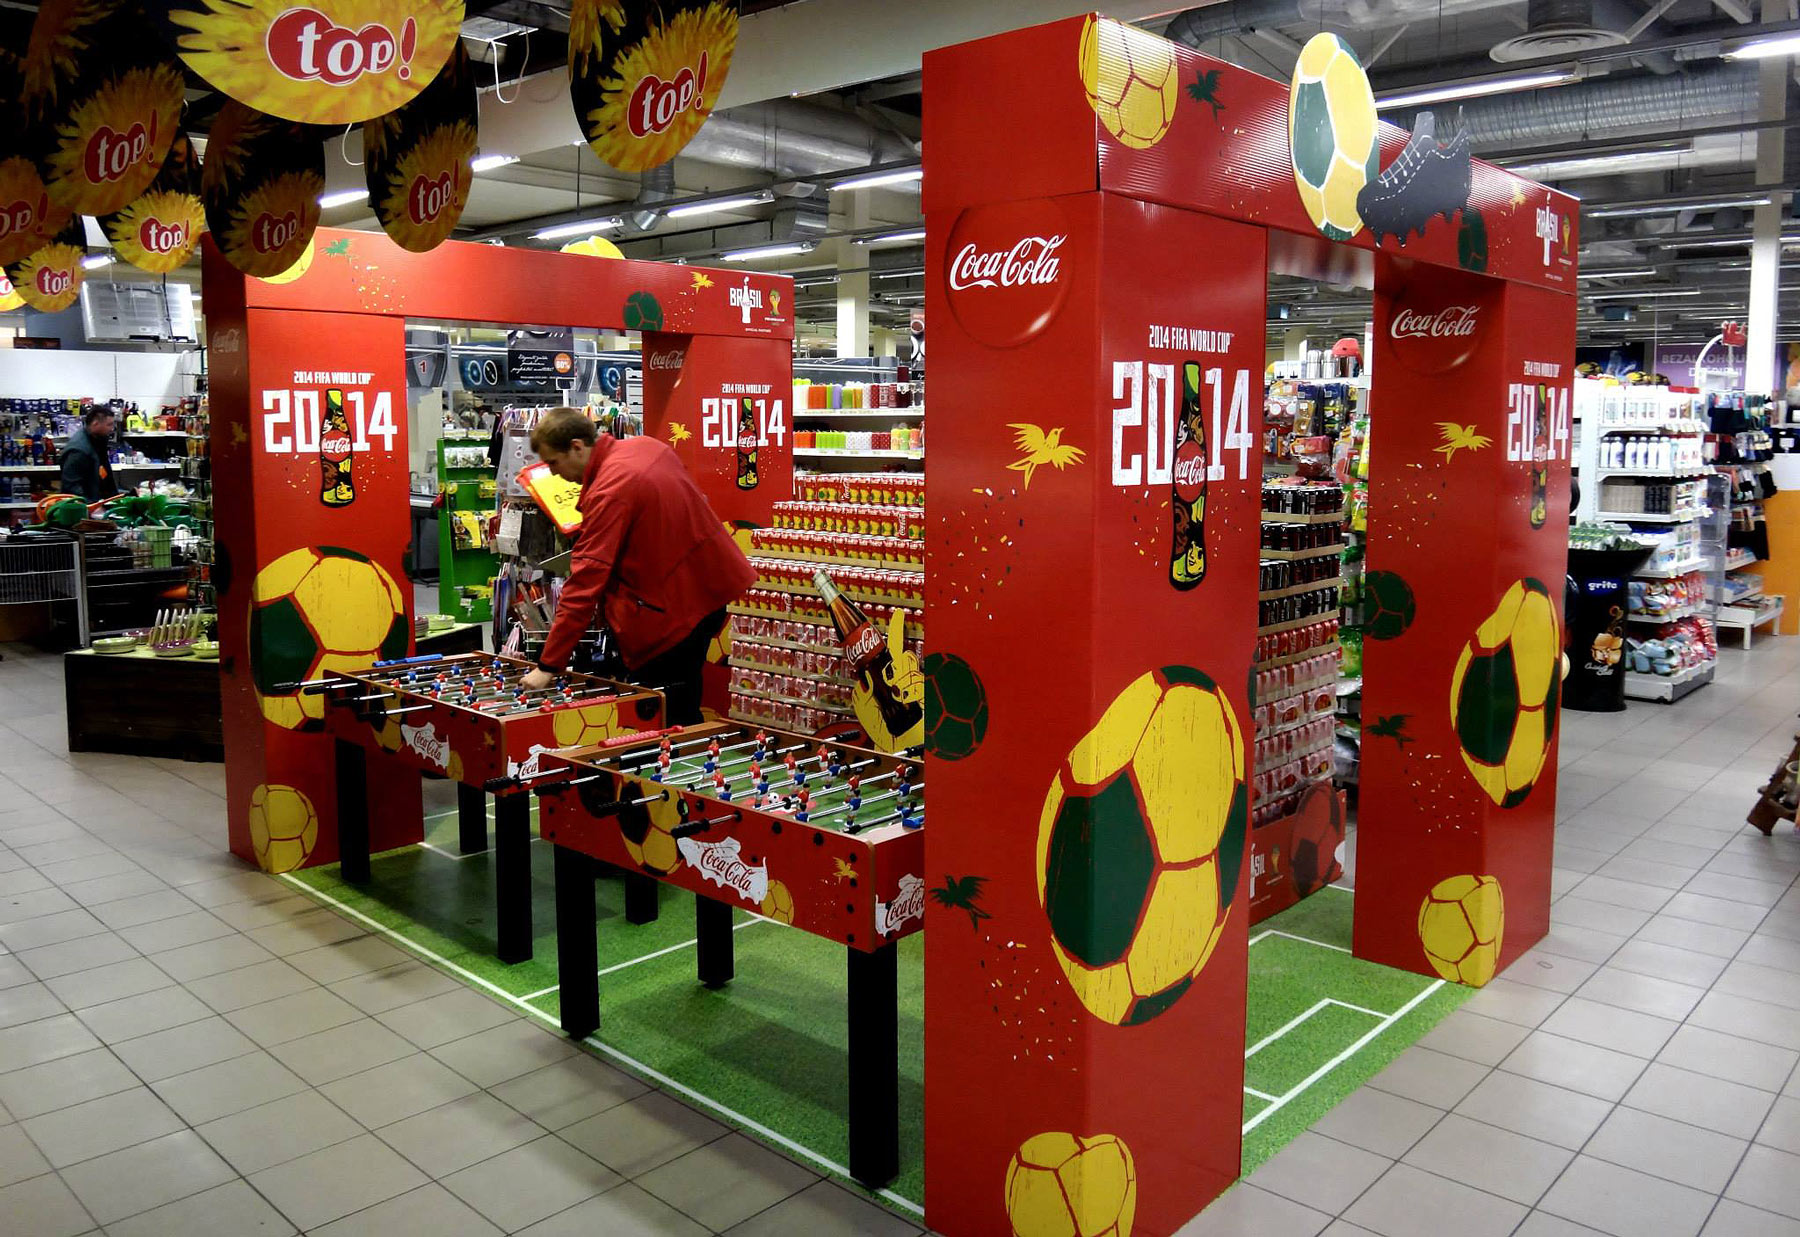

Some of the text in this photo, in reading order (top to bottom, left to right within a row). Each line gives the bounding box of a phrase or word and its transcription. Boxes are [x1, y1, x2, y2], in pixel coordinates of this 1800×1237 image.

[297, 16, 417, 80] top!
[643, 50, 708, 133] top!
[97, 109, 158, 179] top!
[417, 158, 459, 221] top!
[149, 219, 190, 250] top!
[263, 200, 305, 251] top!
[950, 235, 1067, 290] Coca-Cola
[43, 267, 75, 291] top!
[1391, 306, 1480, 338] Coca-Cola
[1149, 325, 1169, 349] 2014
[1171, 327, 1190, 349] FIFA
[1190, 328, 1216, 352] WORLD
[418, 359, 427, 375] 1
[649, 350, 683, 370] Coca-Cola
[294, 371, 313, 384] 2014
[314, 372, 331, 384] FIFA
[331, 372, 357, 384] WORLD
[414, 731, 443, 760] Coca-Cola
[701, 848, 757, 891] Coca-Cola
